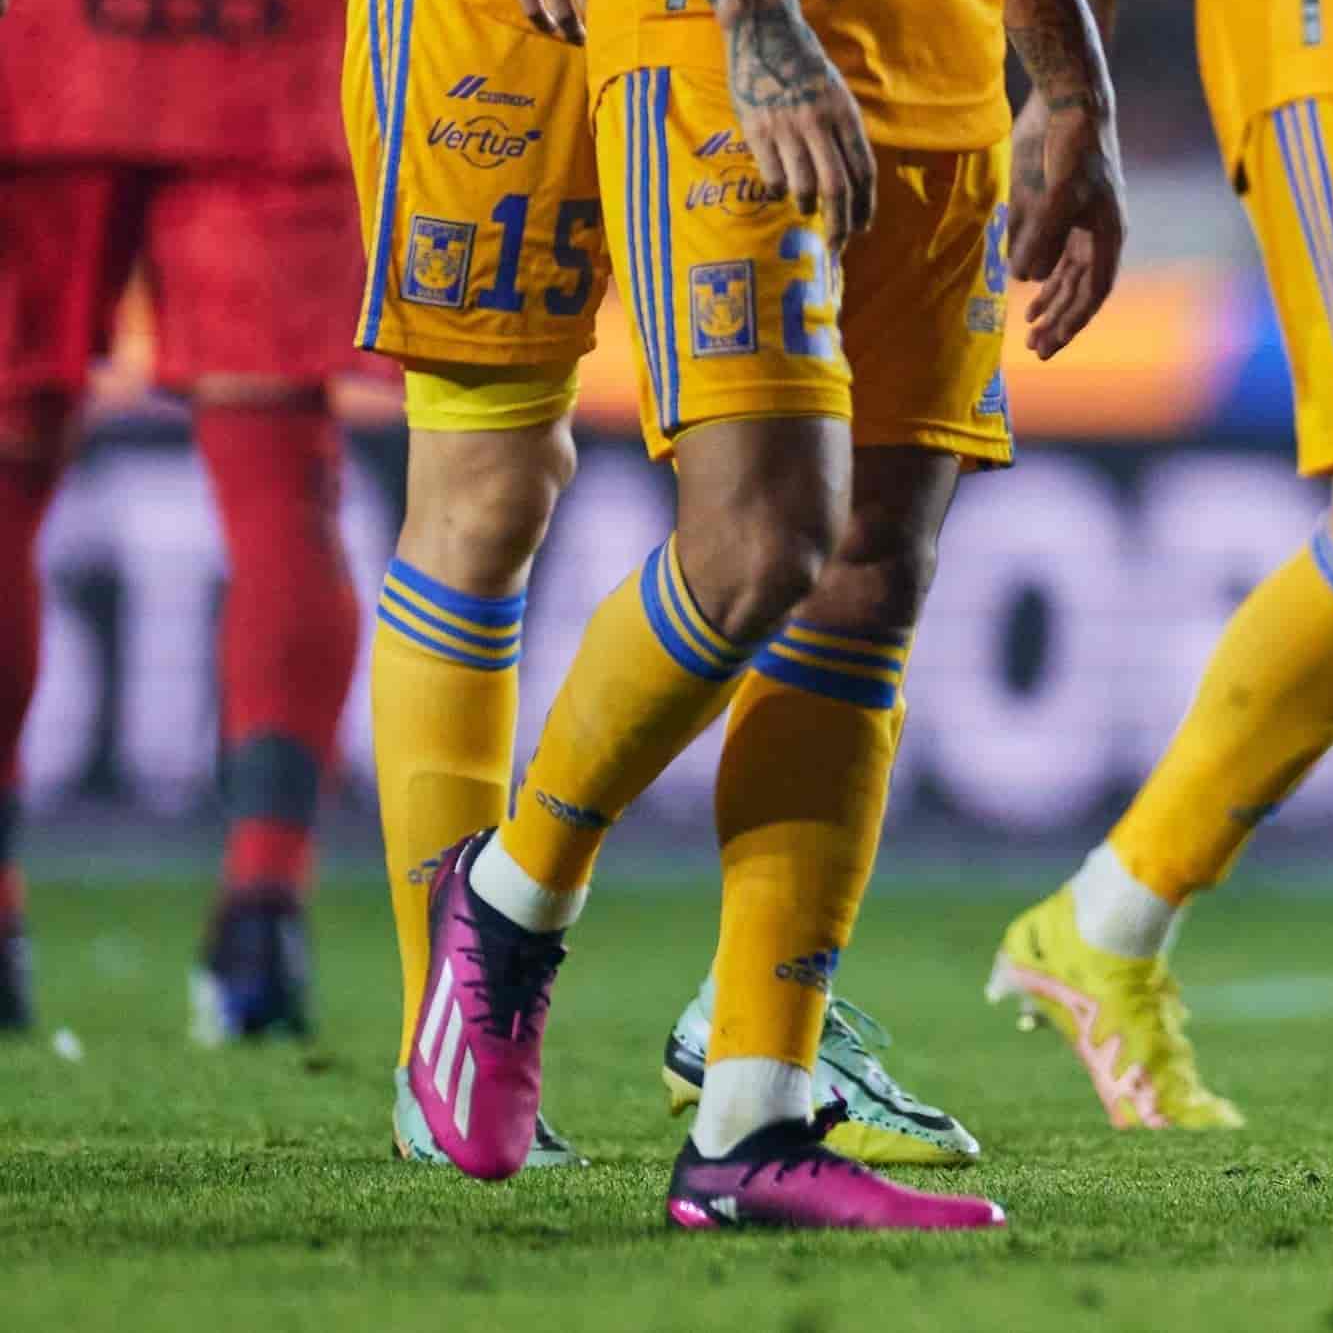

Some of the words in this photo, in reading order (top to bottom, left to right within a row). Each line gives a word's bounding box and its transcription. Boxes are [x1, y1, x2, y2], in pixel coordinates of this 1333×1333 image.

[427, 117, 530, 159] Vertua
[684, 174, 778, 211] Vertu
[475, 193, 602, 316] 15
